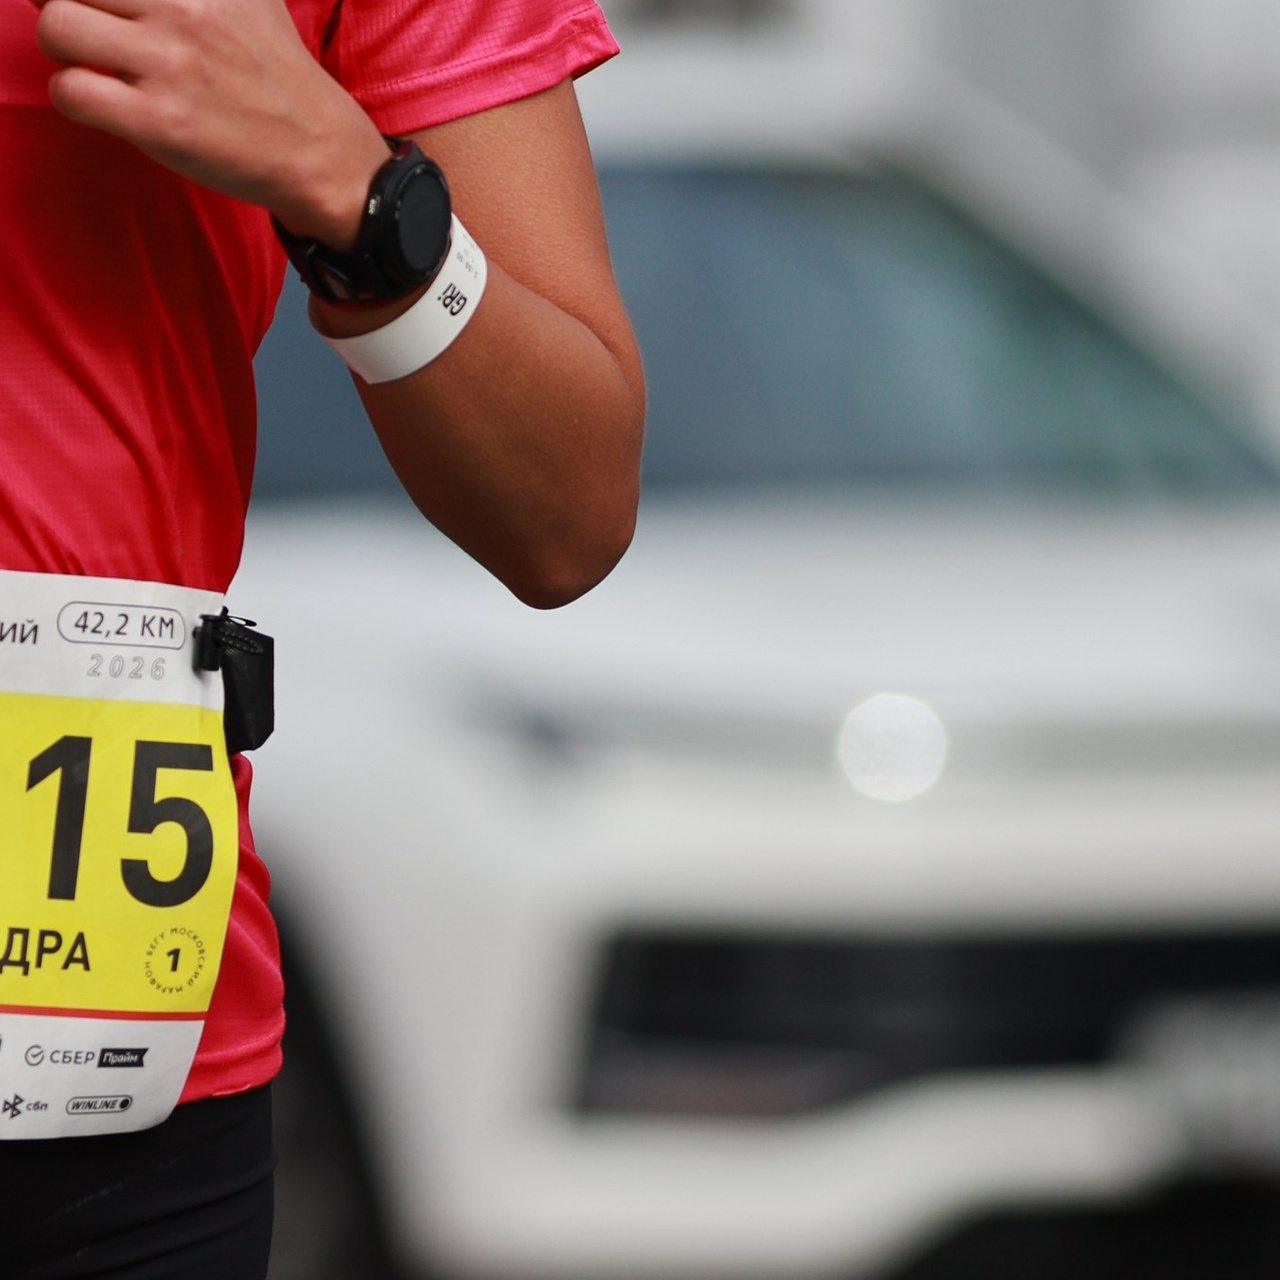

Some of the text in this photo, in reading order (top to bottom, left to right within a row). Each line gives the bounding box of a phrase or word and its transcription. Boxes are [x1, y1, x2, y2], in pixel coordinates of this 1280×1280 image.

[74, 611, 174, 639] 42,2 КМ
[87, 654, 166, 680] 2026
[166, 947, 181, 972] 1
[49, 1050, 139, 1065] СБЕР Прайм
[26, 1100, 48, 1112] сбп
[71, 1099, 119, 1111] WINLINE
